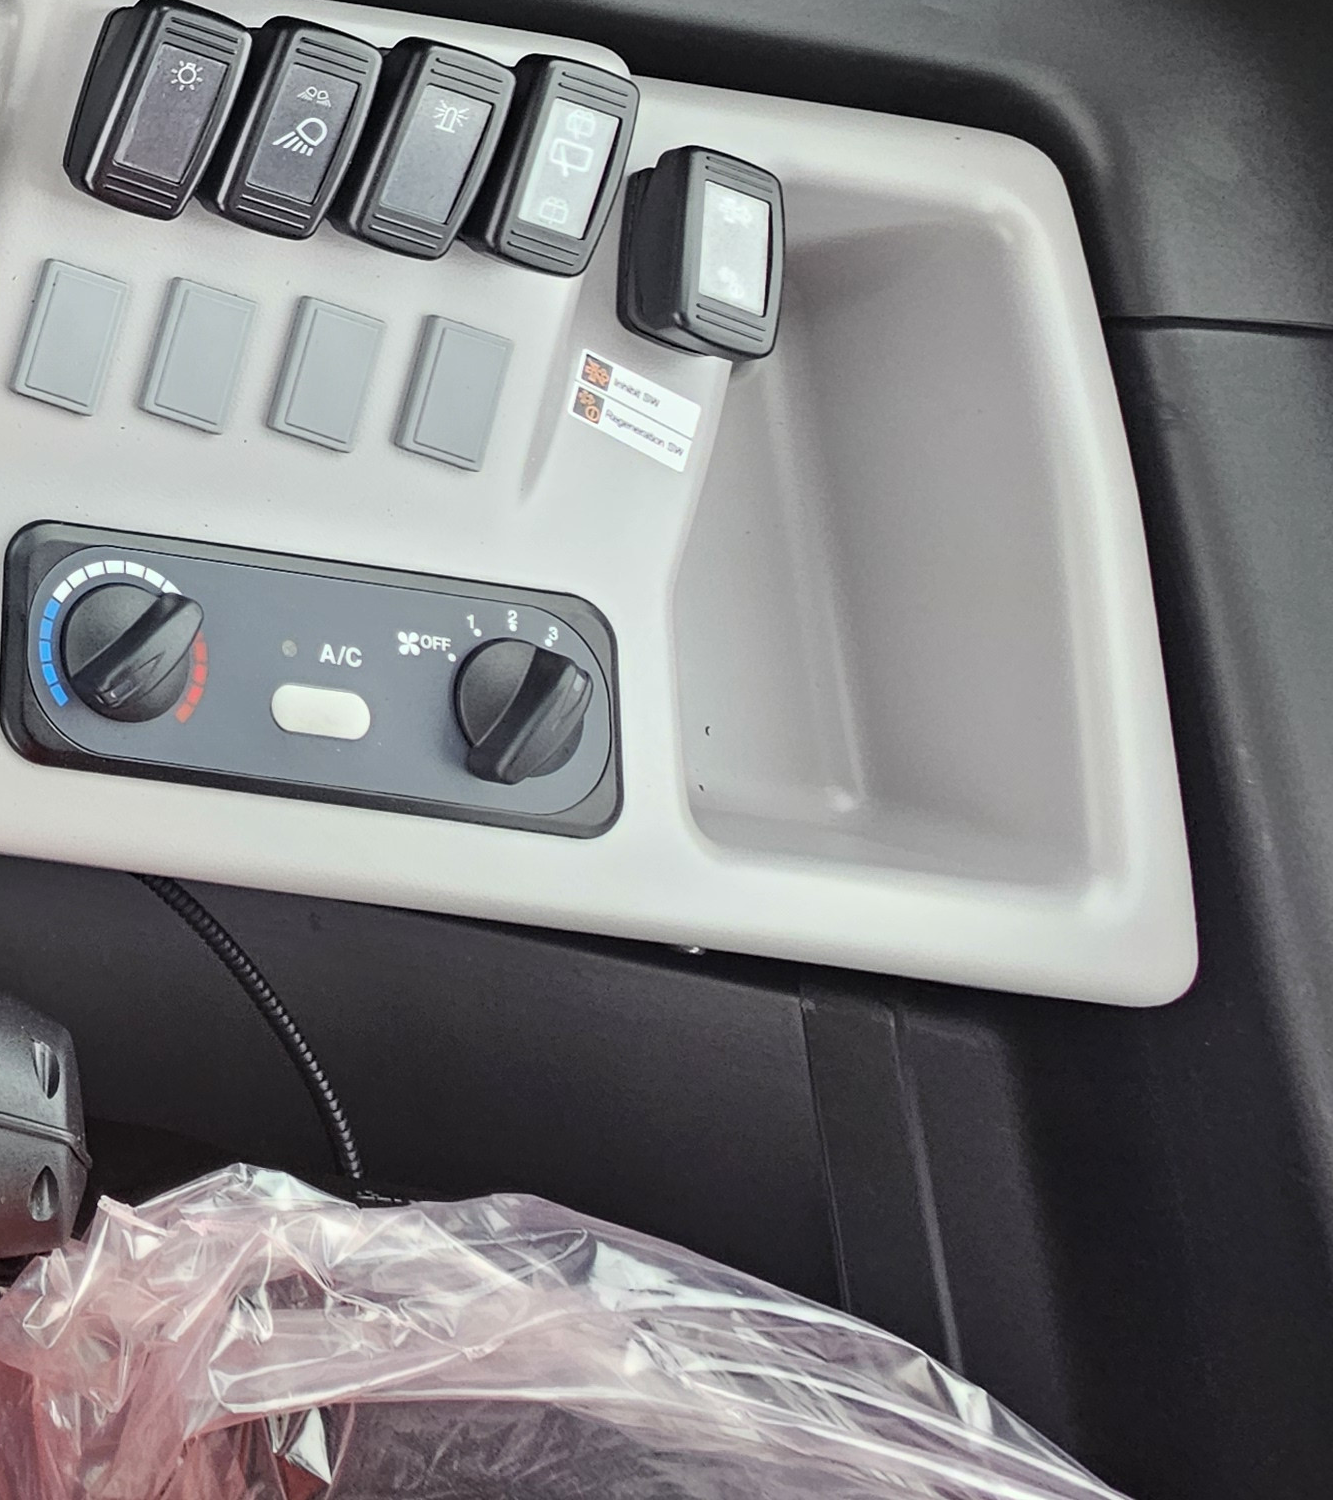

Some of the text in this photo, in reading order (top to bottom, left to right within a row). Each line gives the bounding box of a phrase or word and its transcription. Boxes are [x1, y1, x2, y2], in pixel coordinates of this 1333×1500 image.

[420, 610, 559, 652] OFF 1 2 3
[319, 643, 363, 668] A/C
